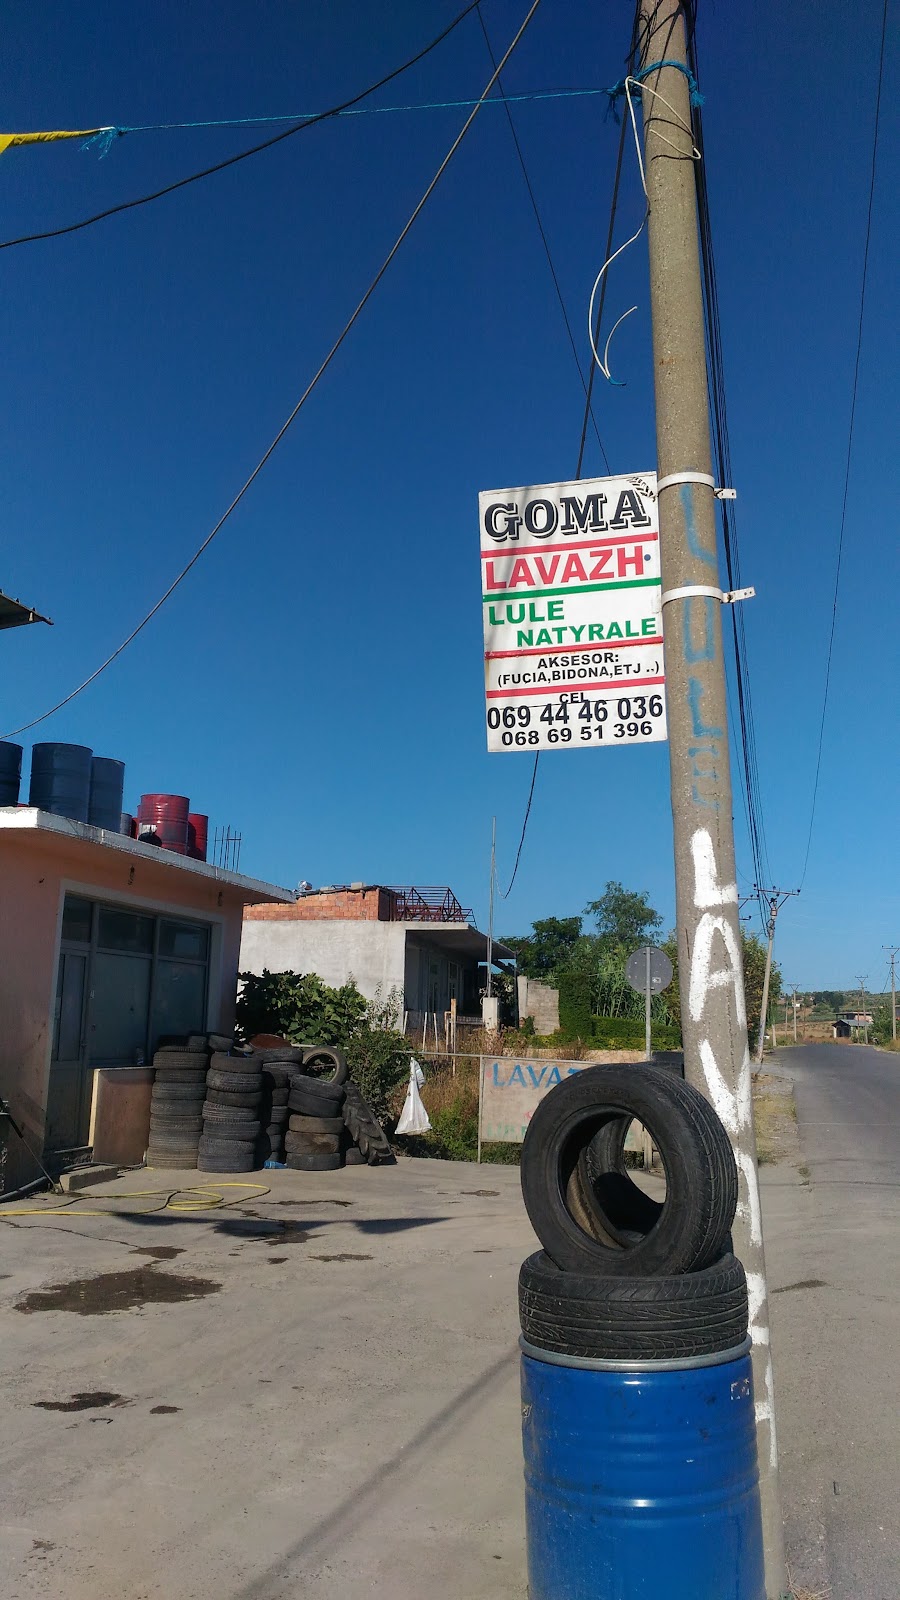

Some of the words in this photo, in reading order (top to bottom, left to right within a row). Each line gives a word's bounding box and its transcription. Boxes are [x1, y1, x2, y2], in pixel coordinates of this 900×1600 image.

[484, 490, 651, 542] GOMA
[485, 545, 644, 590] LAVAZH
[488, 600, 565, 626] LULE
[517, 617, 657, 647] NATYRALE
[537, 652, 619, 669] AKSESOR:
[487, 705, 531, 729] 069
[540, 703, 570, 726] 44
[578, 699, 608, 723] 46
[617, 694, 663, 720] 036
[502, 730, 540, 746] 068
[547, 727, 572, 743] 69
[580, 725, 603, 741] 51
[613, 720, 653, 738] 396
